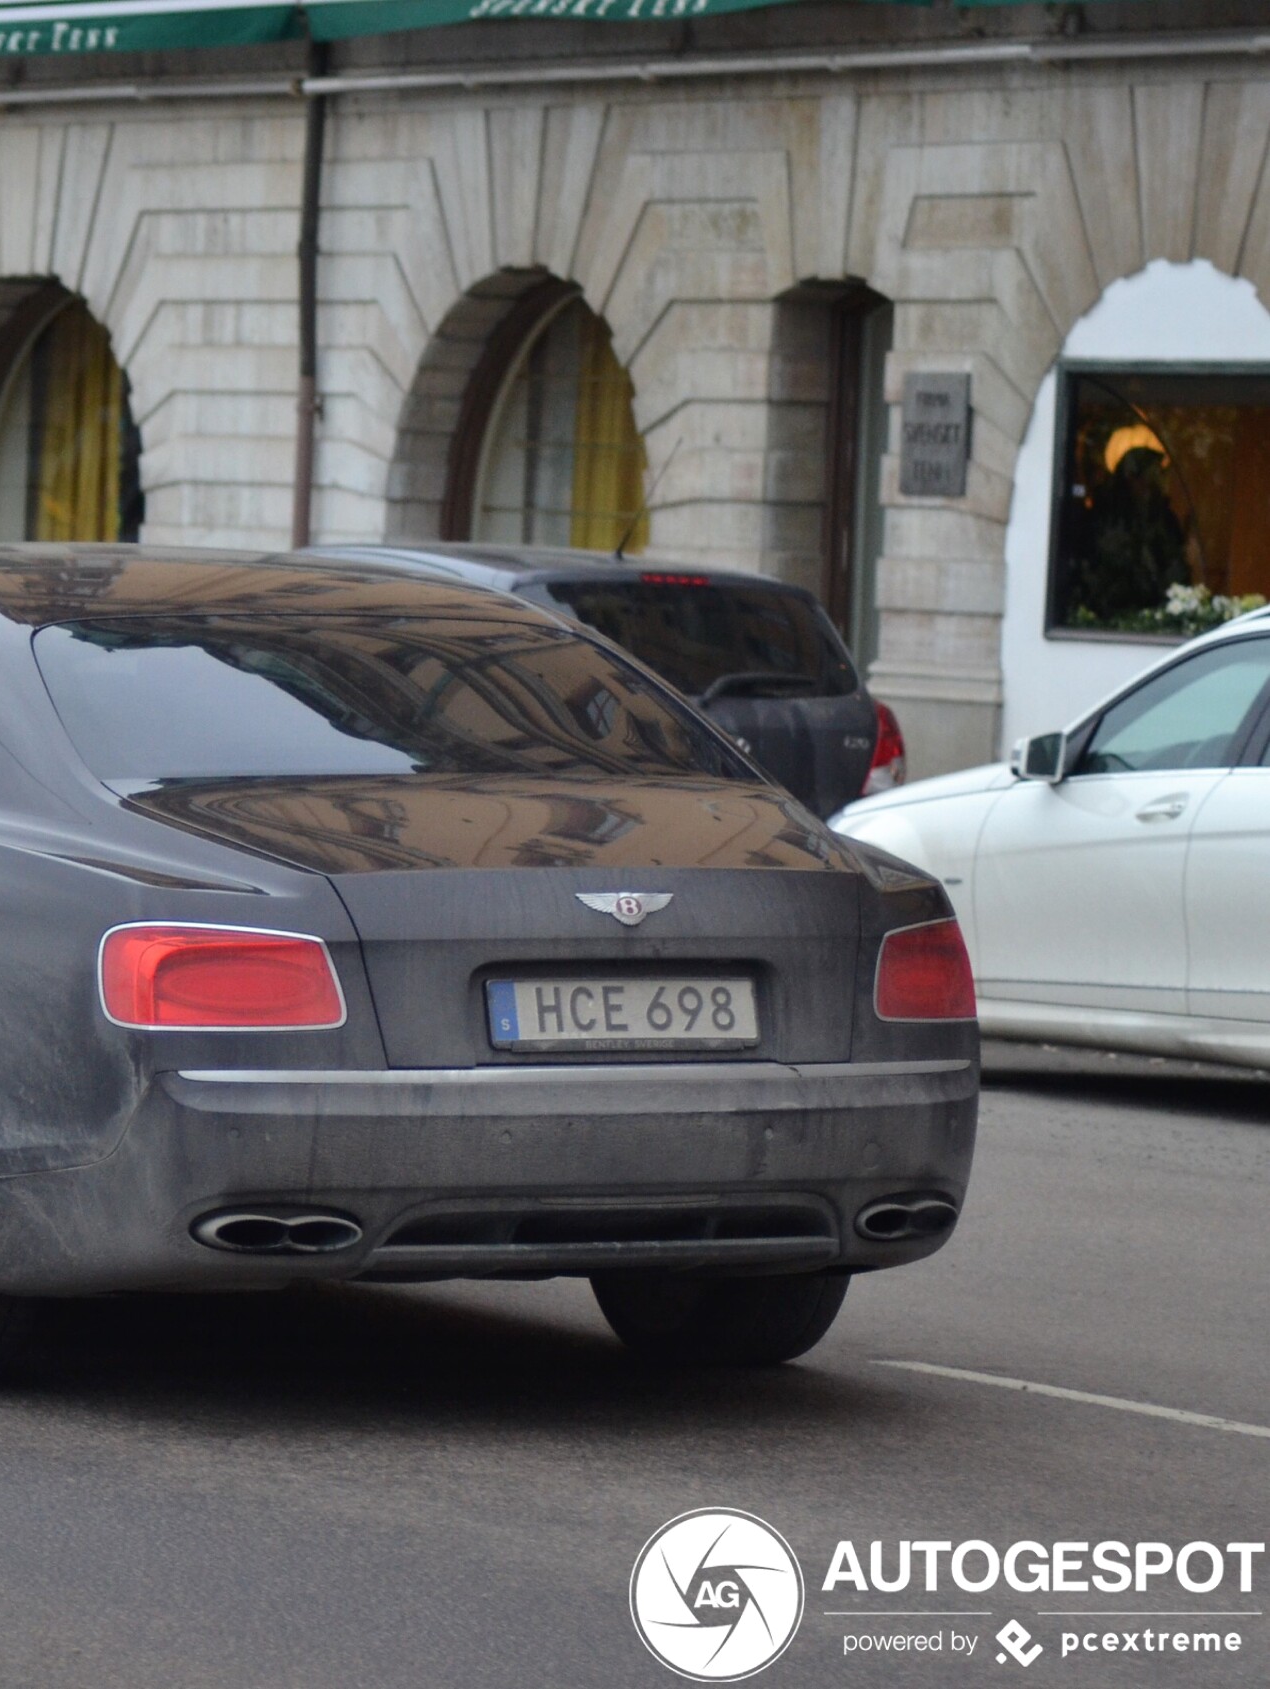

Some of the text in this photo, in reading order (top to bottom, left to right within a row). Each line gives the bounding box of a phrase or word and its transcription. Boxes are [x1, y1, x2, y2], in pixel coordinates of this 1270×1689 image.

[500, 986, 736, 1033] S HCE 698
[585, 1039, 630, 1050] BENTLEY
